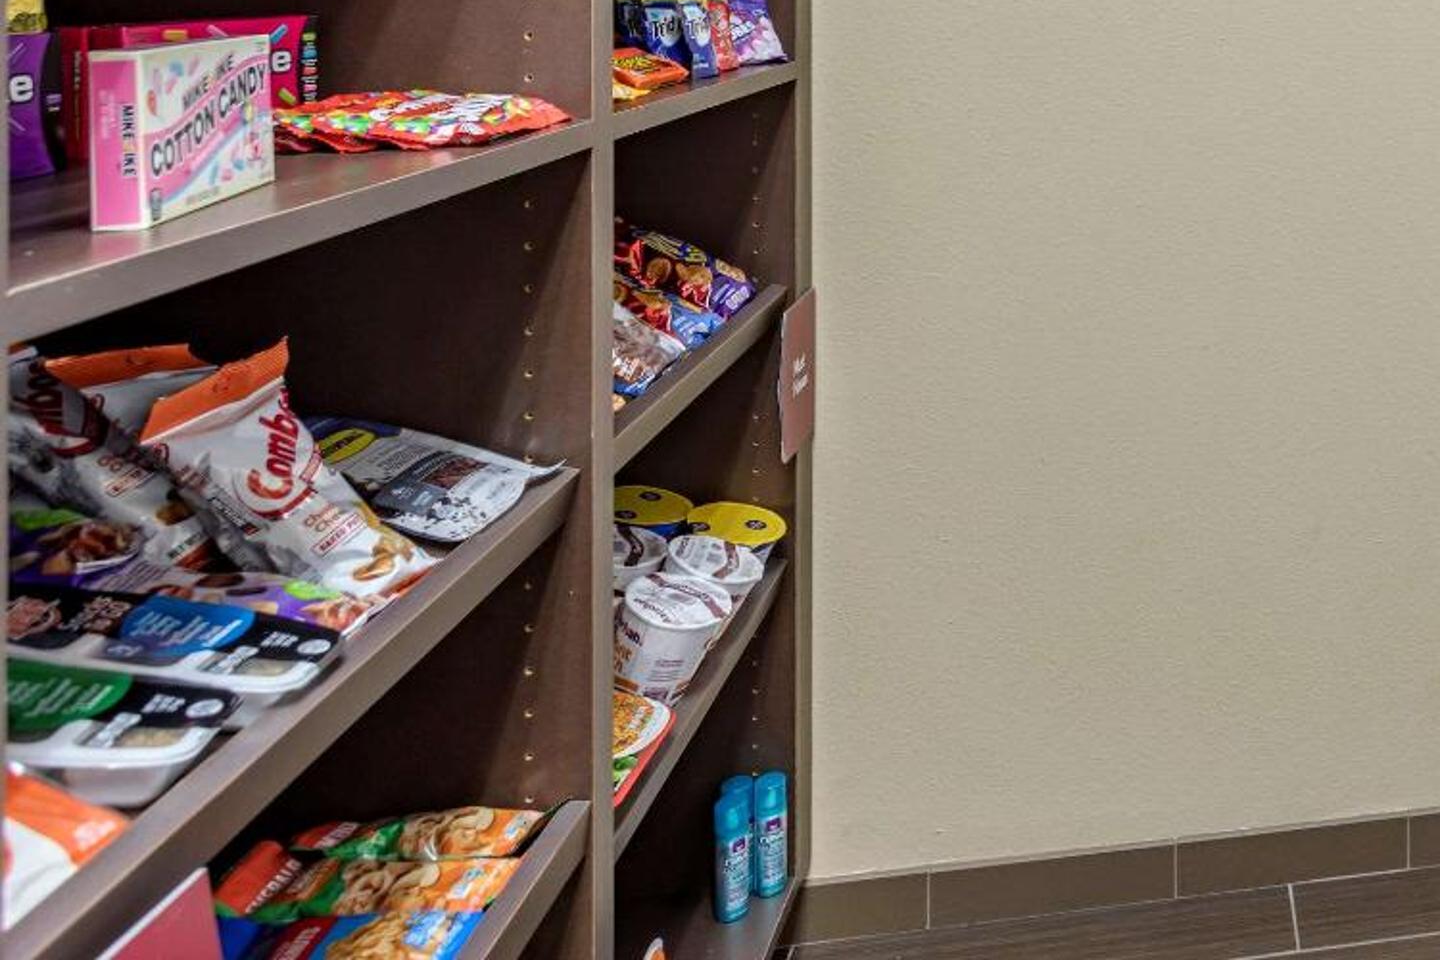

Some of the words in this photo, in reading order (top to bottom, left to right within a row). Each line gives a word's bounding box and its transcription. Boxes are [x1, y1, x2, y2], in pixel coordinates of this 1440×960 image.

[121, 105, 135, 140] MIKE
[151, 103, 216, 176] COTTON
[218, 62, 267, 118] CANDY
[122, 153, 137, 176] IKE
[247, 386, 300, 499] Comb
